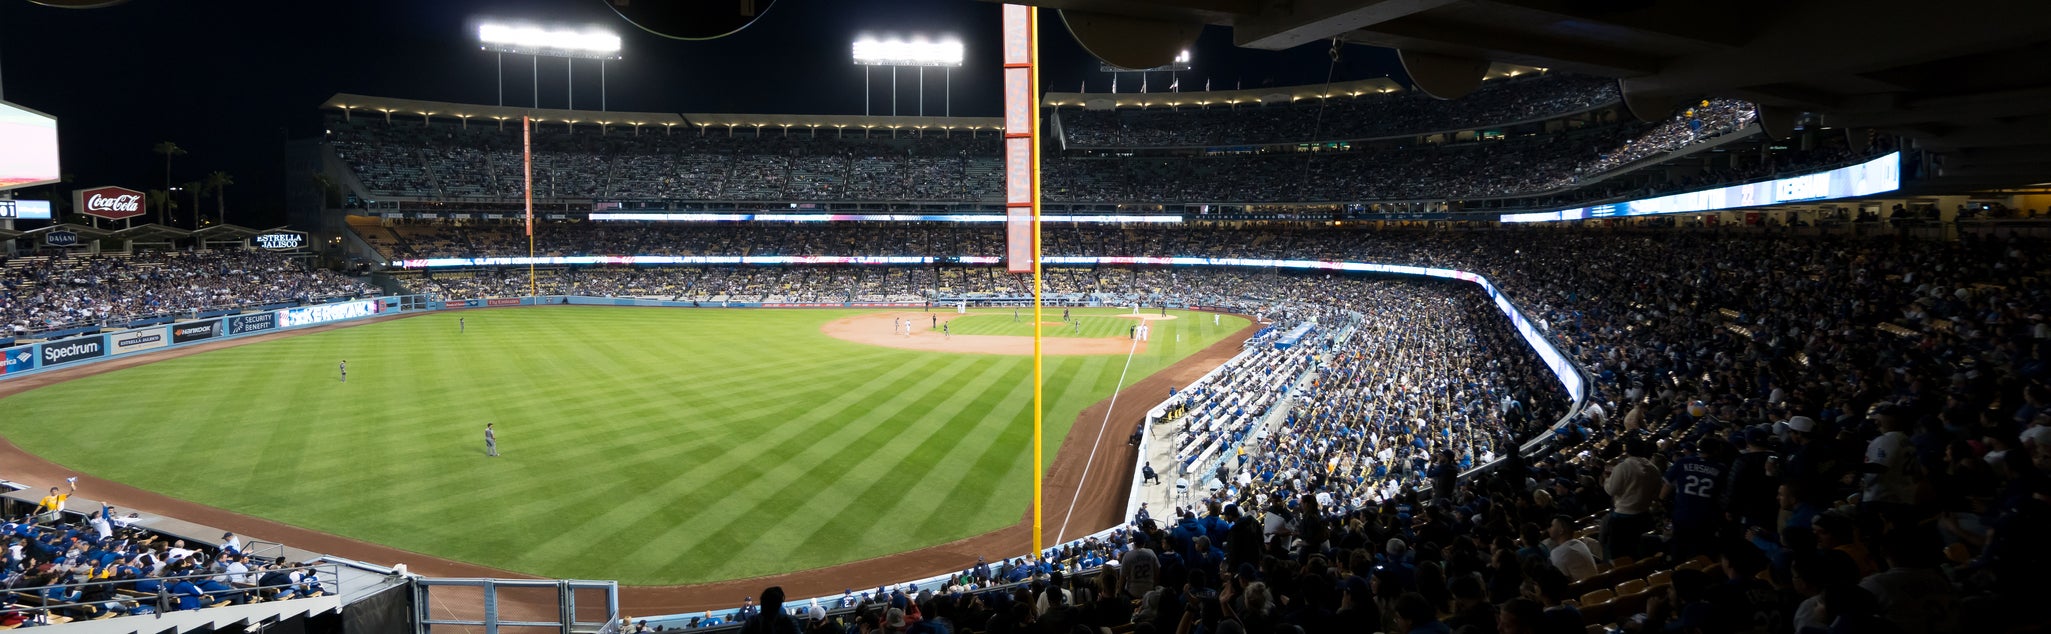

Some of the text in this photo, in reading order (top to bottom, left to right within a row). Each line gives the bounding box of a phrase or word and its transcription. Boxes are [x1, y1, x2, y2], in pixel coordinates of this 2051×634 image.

[257, 234, 302, 242] ESTRELLA
[245, 314, 273, 324] SECURITY
[245, 322, 270, 331] BENEFIT
[45, 343, 98, 361] Spectrum
[1683, 475, 1714, 498] 22
[1134, 564, 1150, 579] 22
